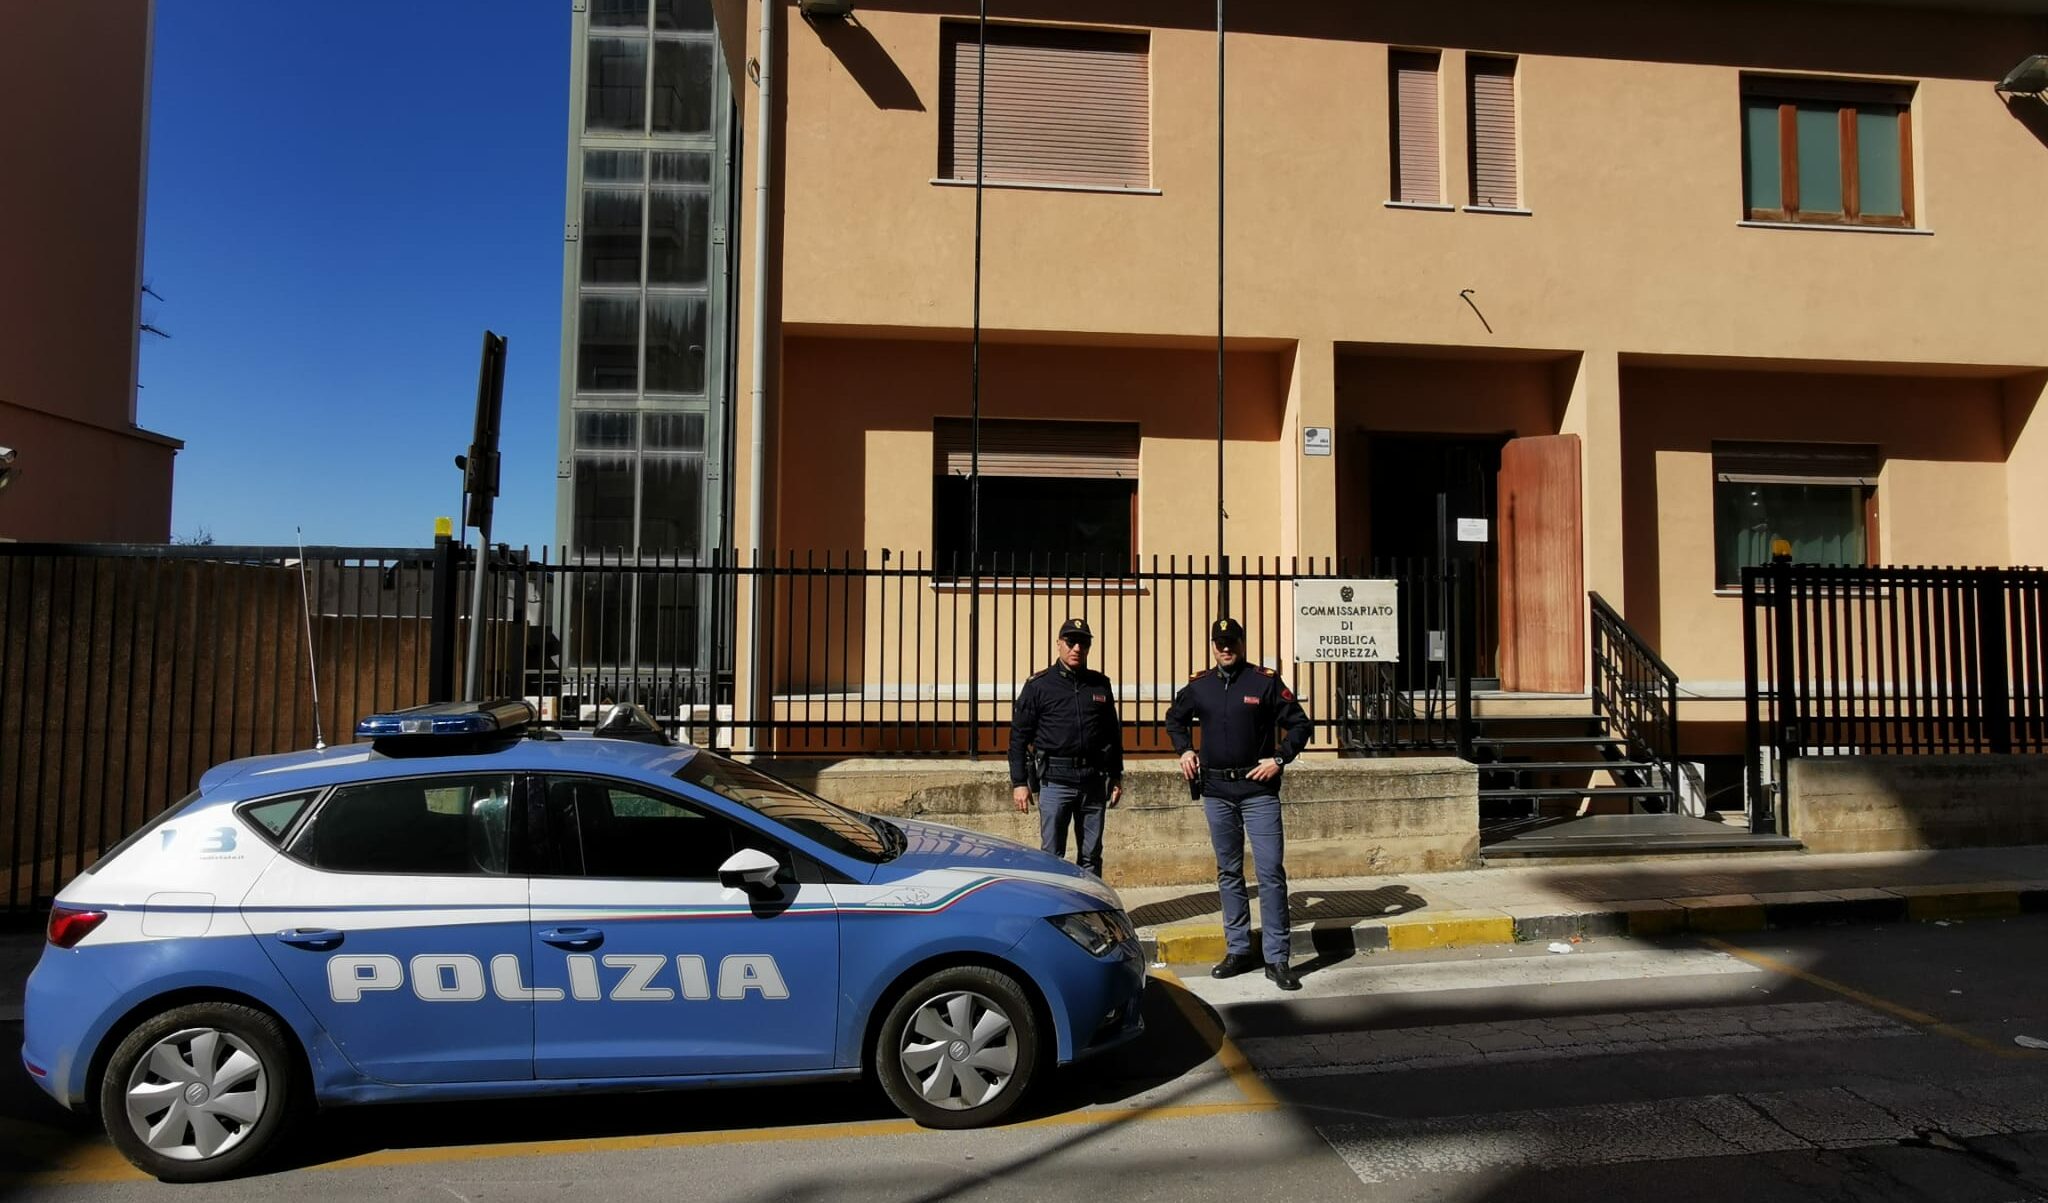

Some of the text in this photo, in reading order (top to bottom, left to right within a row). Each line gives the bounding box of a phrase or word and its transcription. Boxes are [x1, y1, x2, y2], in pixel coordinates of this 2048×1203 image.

[1300, 606, 1394, 616] COMMISSARIATO
[1341, 621, 1353, 630] DI
[1319, 635, 1376, 645] PUBBLICA
[1315, 648, 1379, 658] SICUREZZA
[326, 953, 791, 1003] POLIZIA
